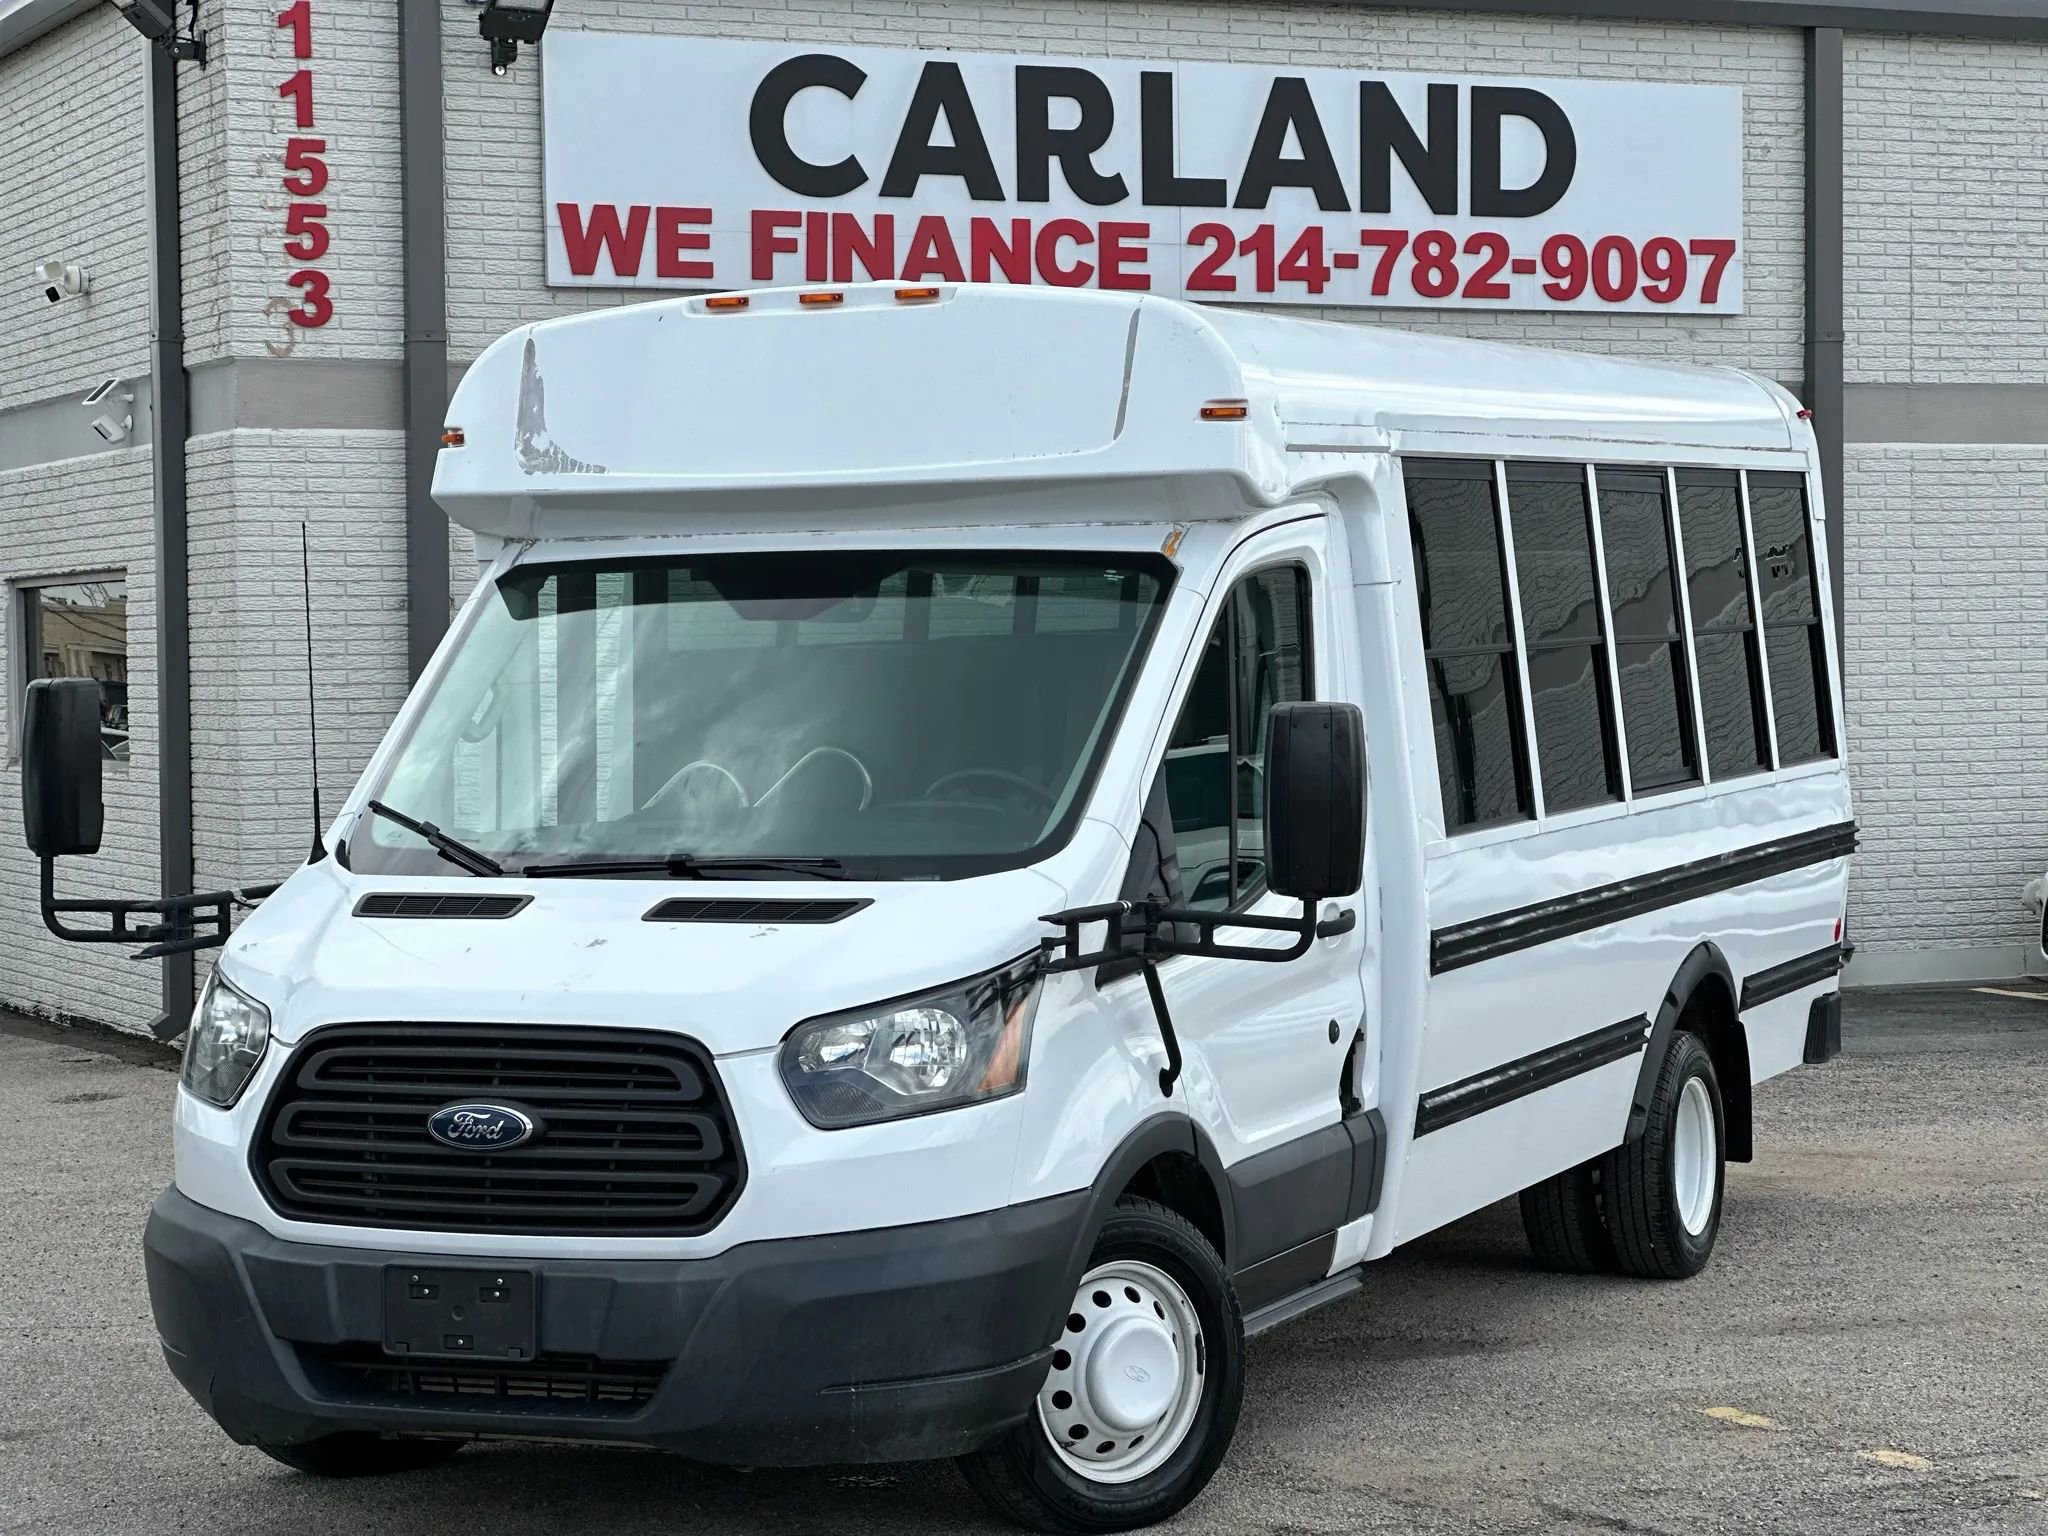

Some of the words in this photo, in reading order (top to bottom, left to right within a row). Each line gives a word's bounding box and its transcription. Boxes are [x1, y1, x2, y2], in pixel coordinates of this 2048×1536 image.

[277, 0, 333, 328] 11553
[749, 53, 1577, 218] CARLAND
[556, 203, 714, 279] WE
[751, 209, 1151, 289] FINANCE
[1186, 222, 1737, 304] 214-782-9097
[447, 1111, 505, 1139] Ford
